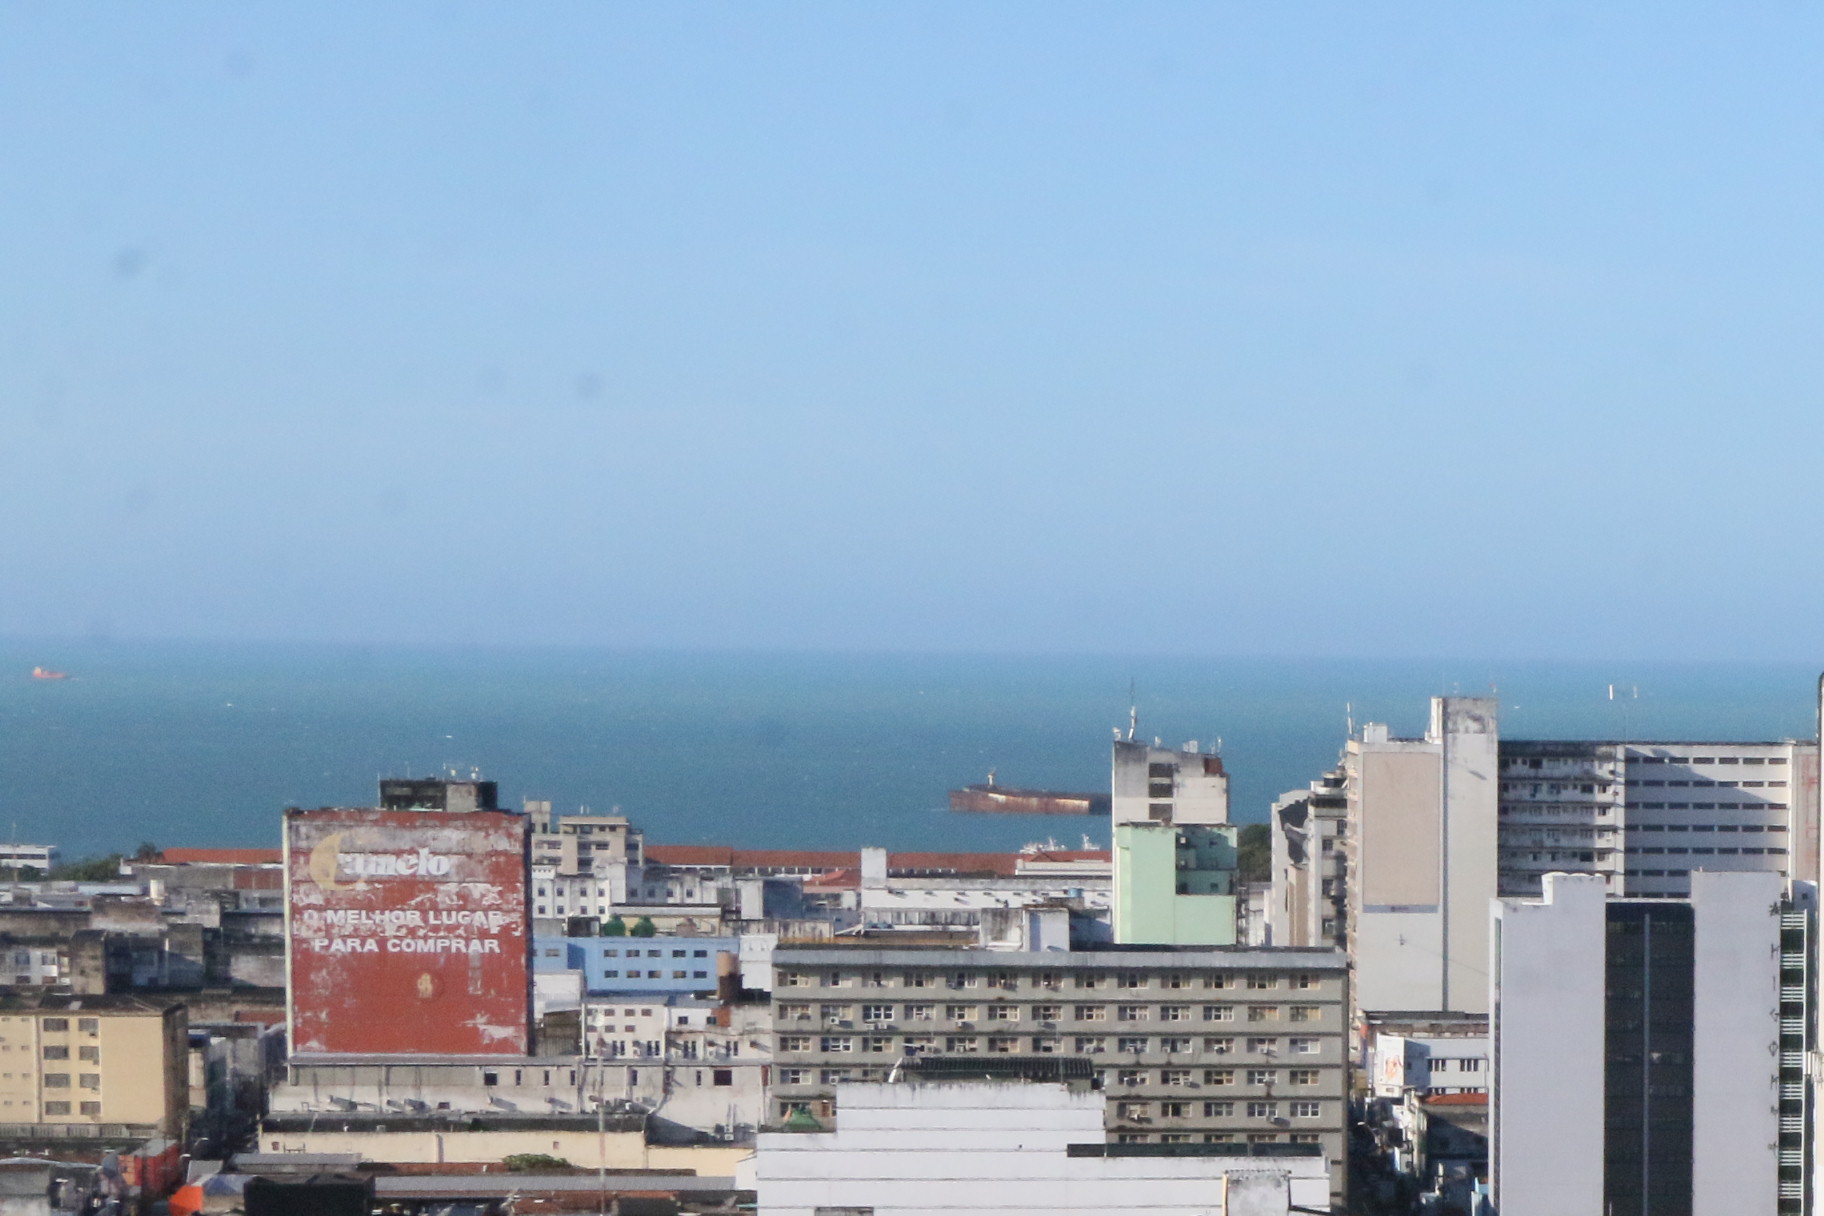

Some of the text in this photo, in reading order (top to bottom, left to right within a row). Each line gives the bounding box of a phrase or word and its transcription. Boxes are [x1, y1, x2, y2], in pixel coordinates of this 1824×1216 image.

[326, 910, 422, 925] MELHOR
[429, 911, 504, 928] LUGAR
[314, 938, 501, 953] PARA COMPRAR
